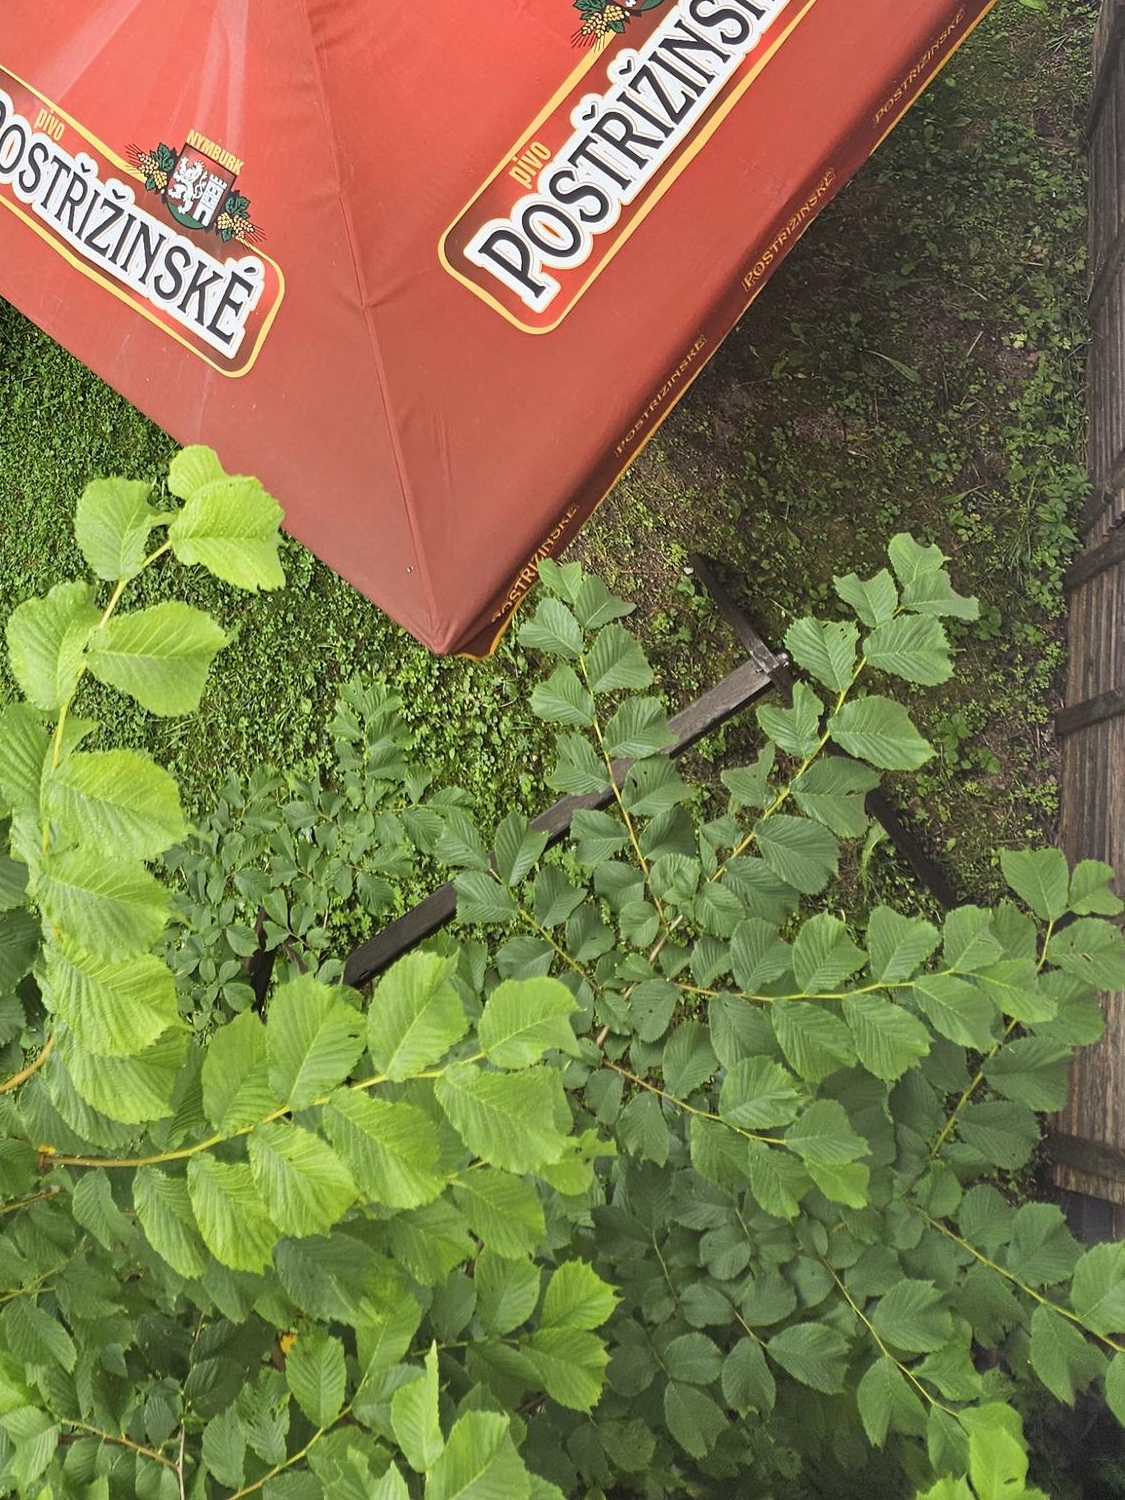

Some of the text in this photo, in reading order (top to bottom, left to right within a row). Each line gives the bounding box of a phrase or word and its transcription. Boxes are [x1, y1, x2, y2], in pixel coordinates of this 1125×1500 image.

[34, 106, 66, 141] pivo
[186, 129, 245, 176] NYMBURK
[508, 141, 552, 190] pivo
